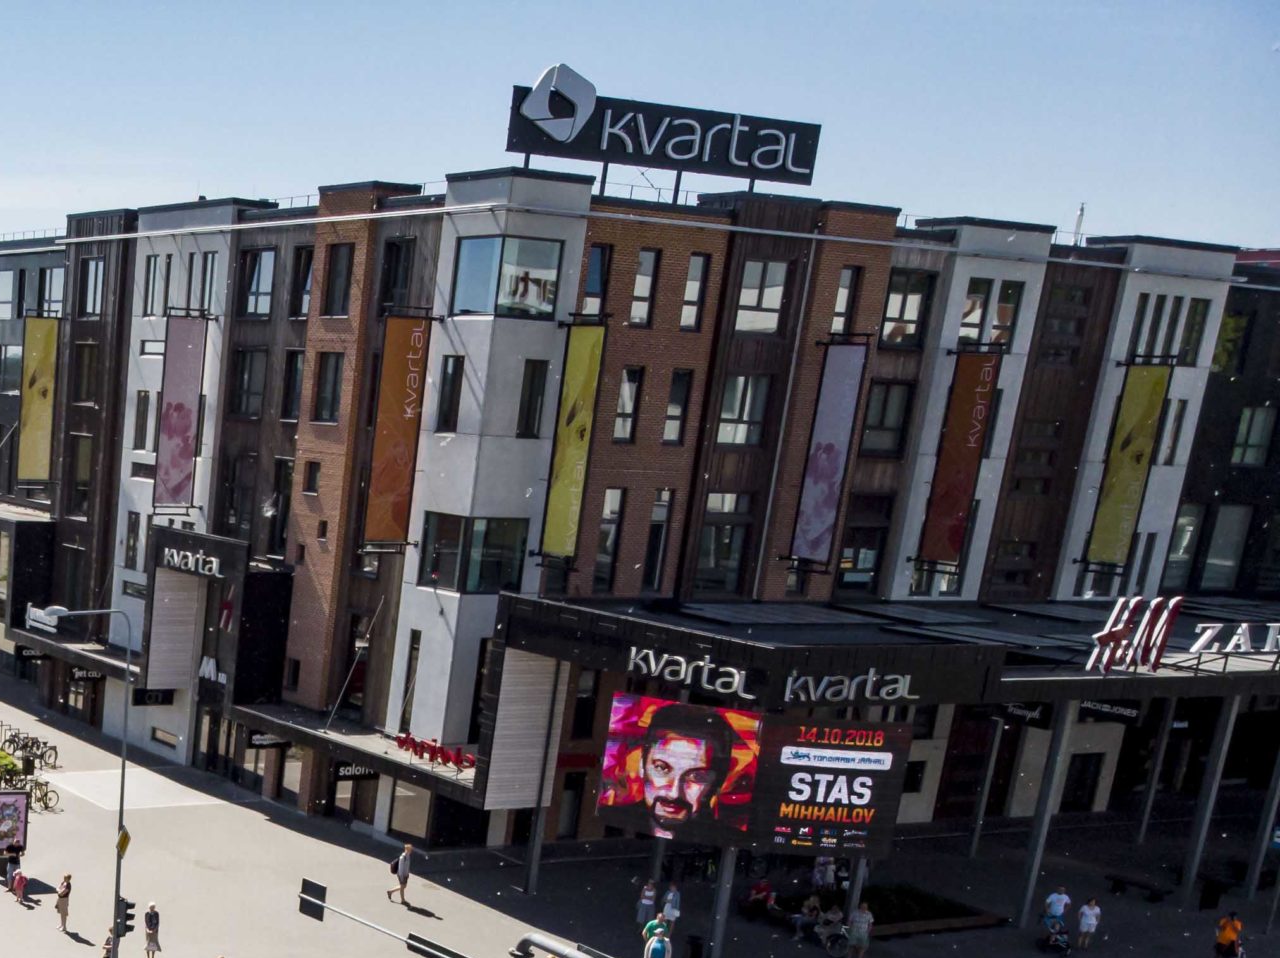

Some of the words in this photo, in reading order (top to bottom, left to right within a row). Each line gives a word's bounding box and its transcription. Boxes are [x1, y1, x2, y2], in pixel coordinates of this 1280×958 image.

[797, 726, 885, 747] 14.10.2018
[788, 772, 873, 805] STAS
[780, 802, 876, 824] MIHHAILOV
